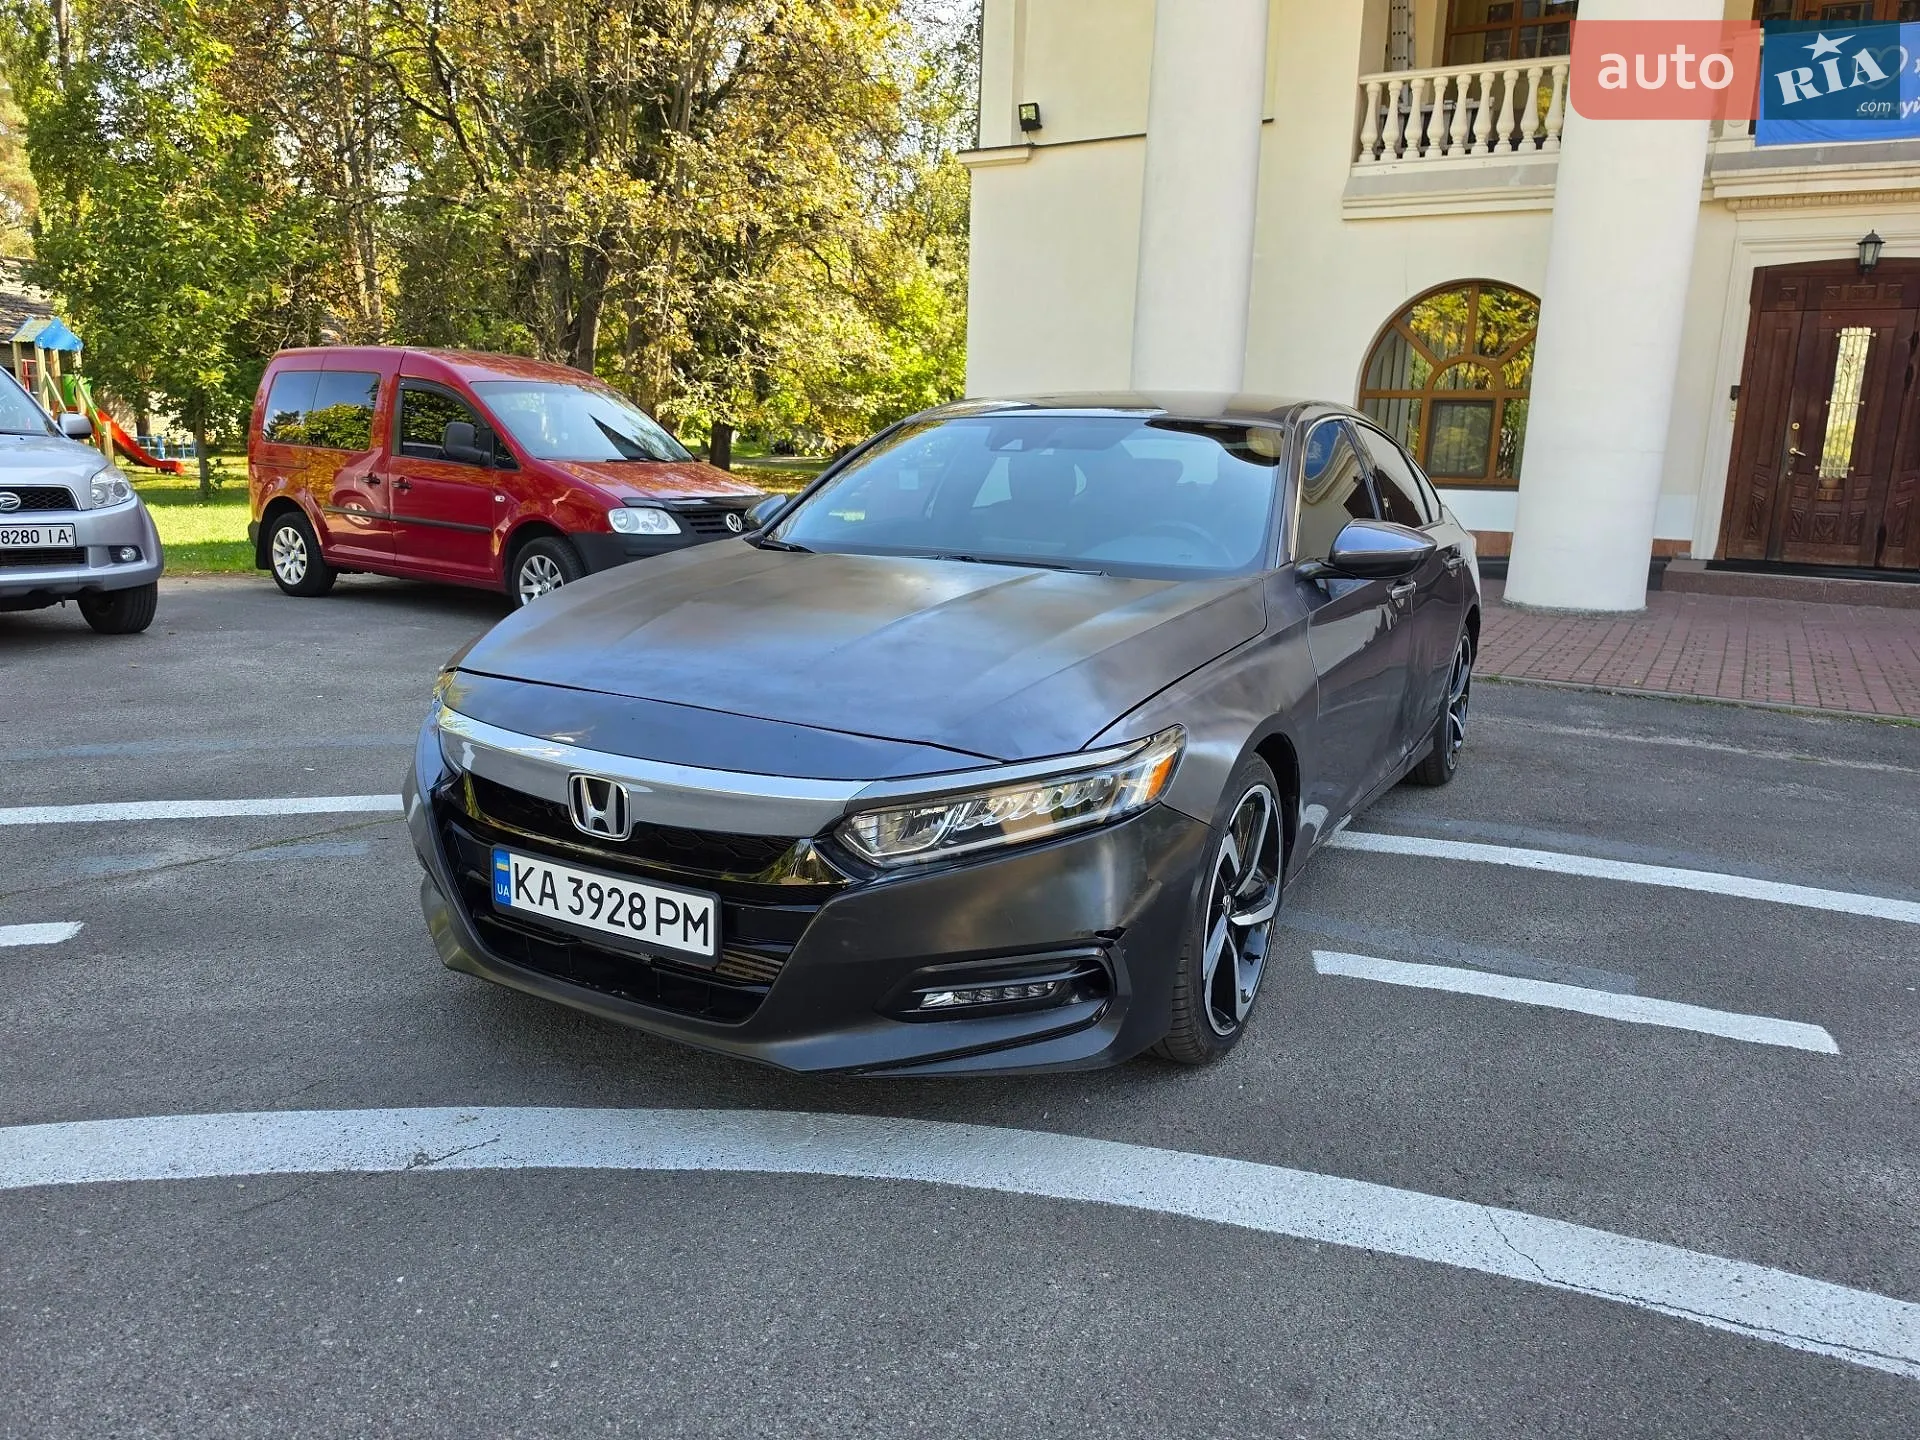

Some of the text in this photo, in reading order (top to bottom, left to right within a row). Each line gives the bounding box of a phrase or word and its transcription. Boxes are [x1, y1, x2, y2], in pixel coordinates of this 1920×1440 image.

[0, 529, 40, 545] 8280
[497, 883, 510, 897] UA
[514, 863, 709, 947] KA 3928 PM
